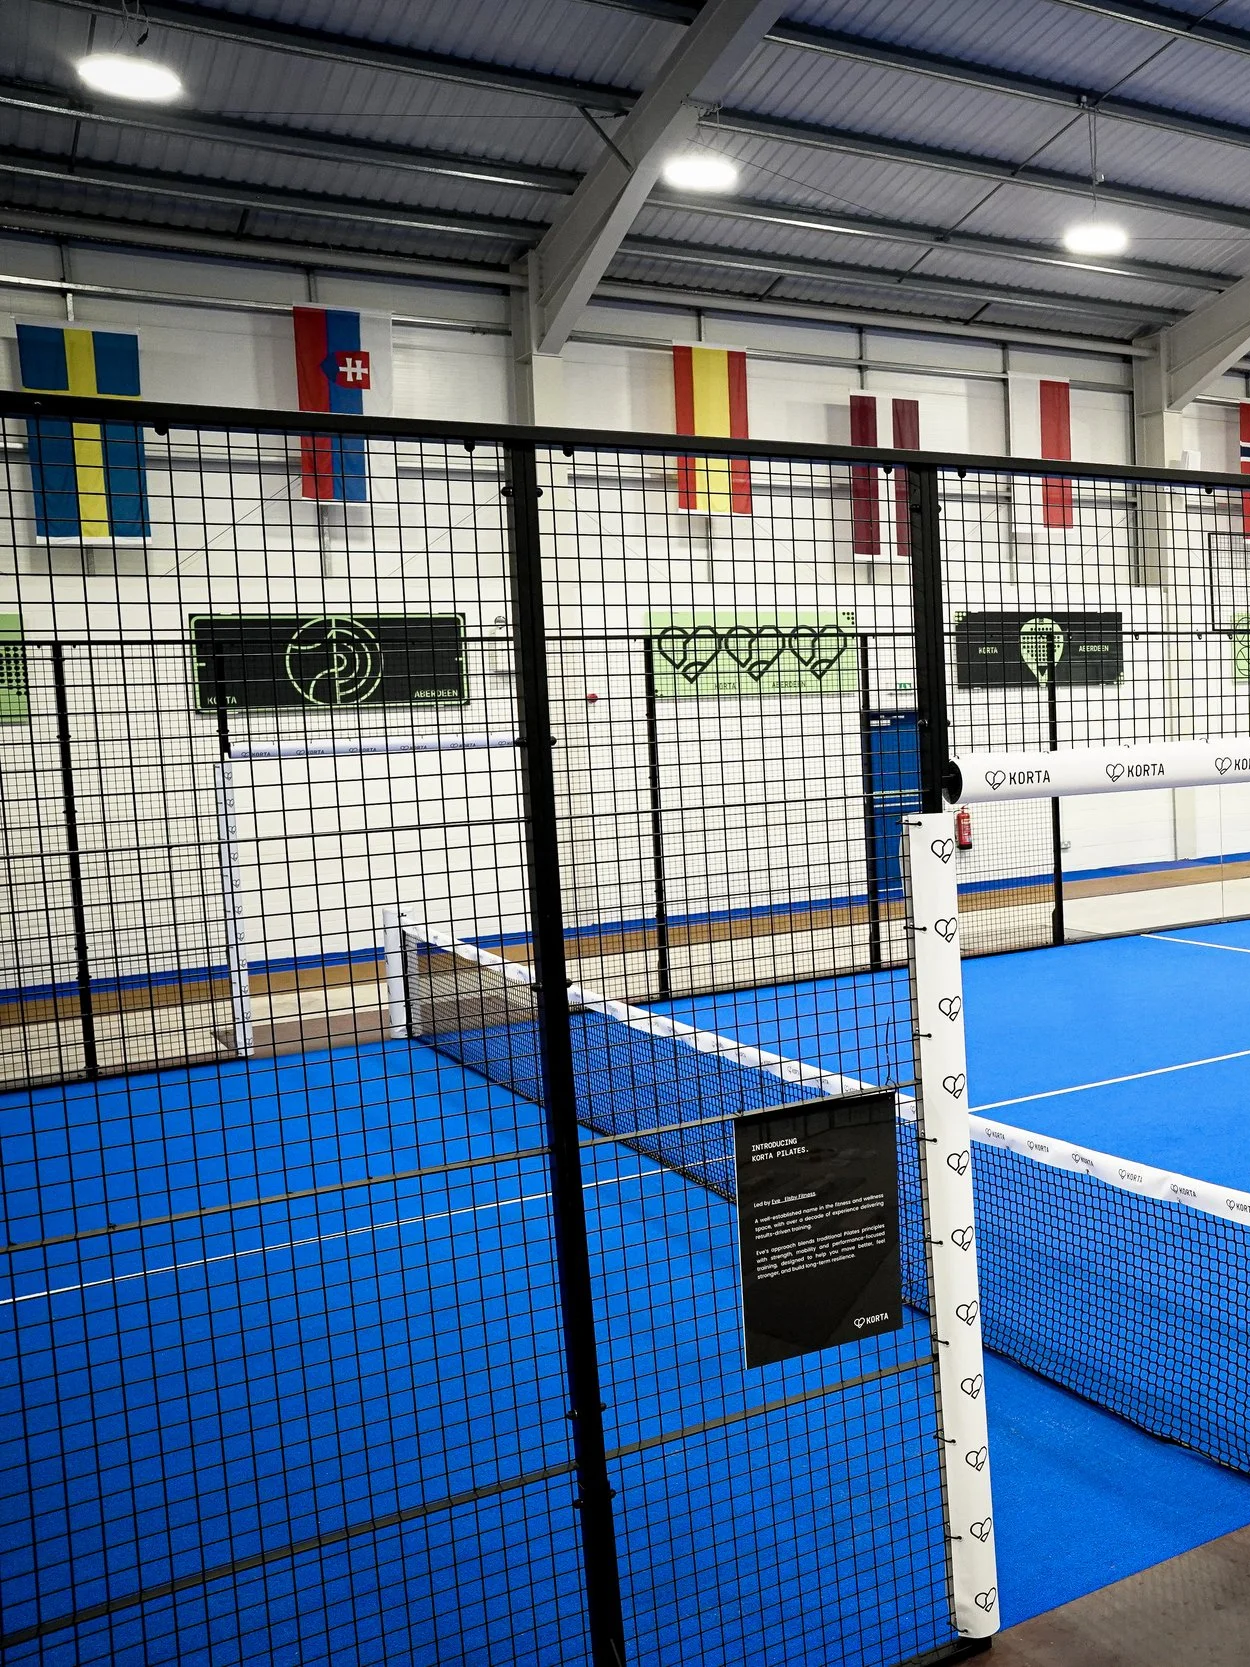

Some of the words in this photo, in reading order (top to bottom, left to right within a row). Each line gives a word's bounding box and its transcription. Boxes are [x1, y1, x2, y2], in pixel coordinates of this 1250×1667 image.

[207, 697, 237, 705] KOTA
[1009, 770, 1050, 785] KORTA
[1127, 763, 1165, 777] KORTA
[752, 1138, 798, 1152] INTRODUCING
[752, 1152, 774, 1162] KORTA
[776, 1147, 809, 1158] PILATES.
[832, 1206, 859, 1216] experience
[860, 1201, 884, 1210] delivering
[760, 1210, 802, 1222] well-established
[756, 1229, 791, 1240] results-driven
[771, 1243, 796, 1254] approach
[798, 1239, 815, 1247] blends
[817, 1232, 842, 1242] traditional
[862, 1223, 885, 1233] principles
[796, 1246, 816, 1255] mobility
[832, 1231, 885, 1248] performance-focused
[781, 1256, 804, 1266] designed
[806, 1259, 830, 1269] long-term
[866, 1312, 888, 1324] KORTA
